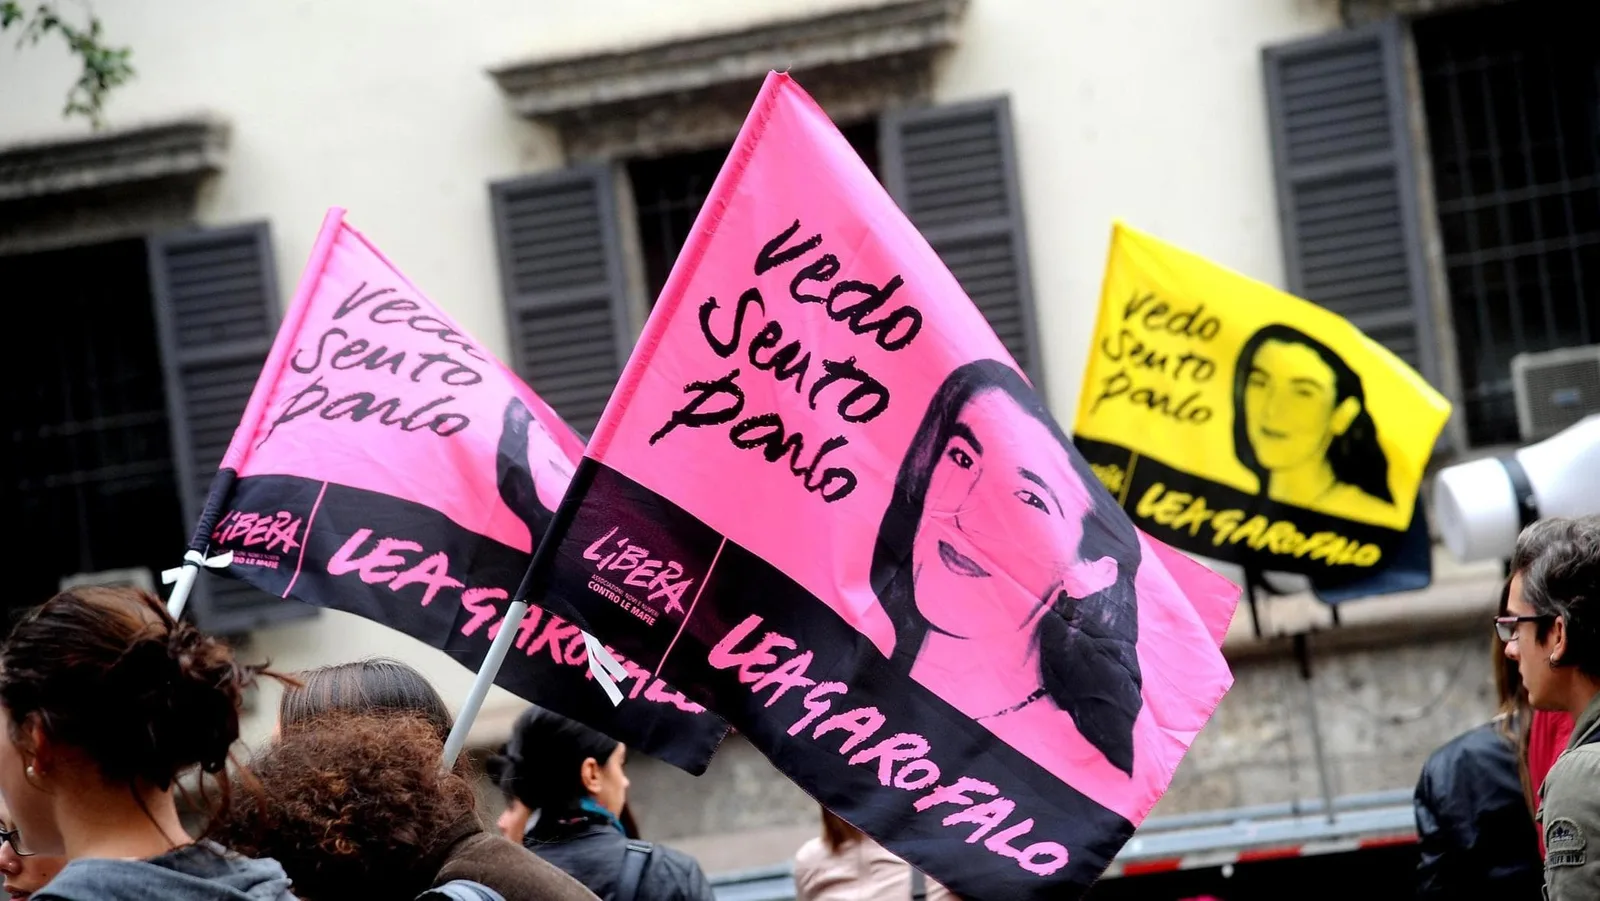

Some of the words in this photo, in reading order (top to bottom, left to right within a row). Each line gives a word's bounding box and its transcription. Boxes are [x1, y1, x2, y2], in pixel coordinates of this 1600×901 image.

[1135, 482, 1214, 537] LEA
[1211, 508, 1382, 568] GAROFALO
[327, 528, 466, 607] LEA
[587, 580, 621, 604] CONTRO
[620, 599, 632, 611] LE
[630, 606, 656, 626] MAFIE
[708, 614, 816, 707] LEA
[787, 680, 1070, 877] GAROFALO
